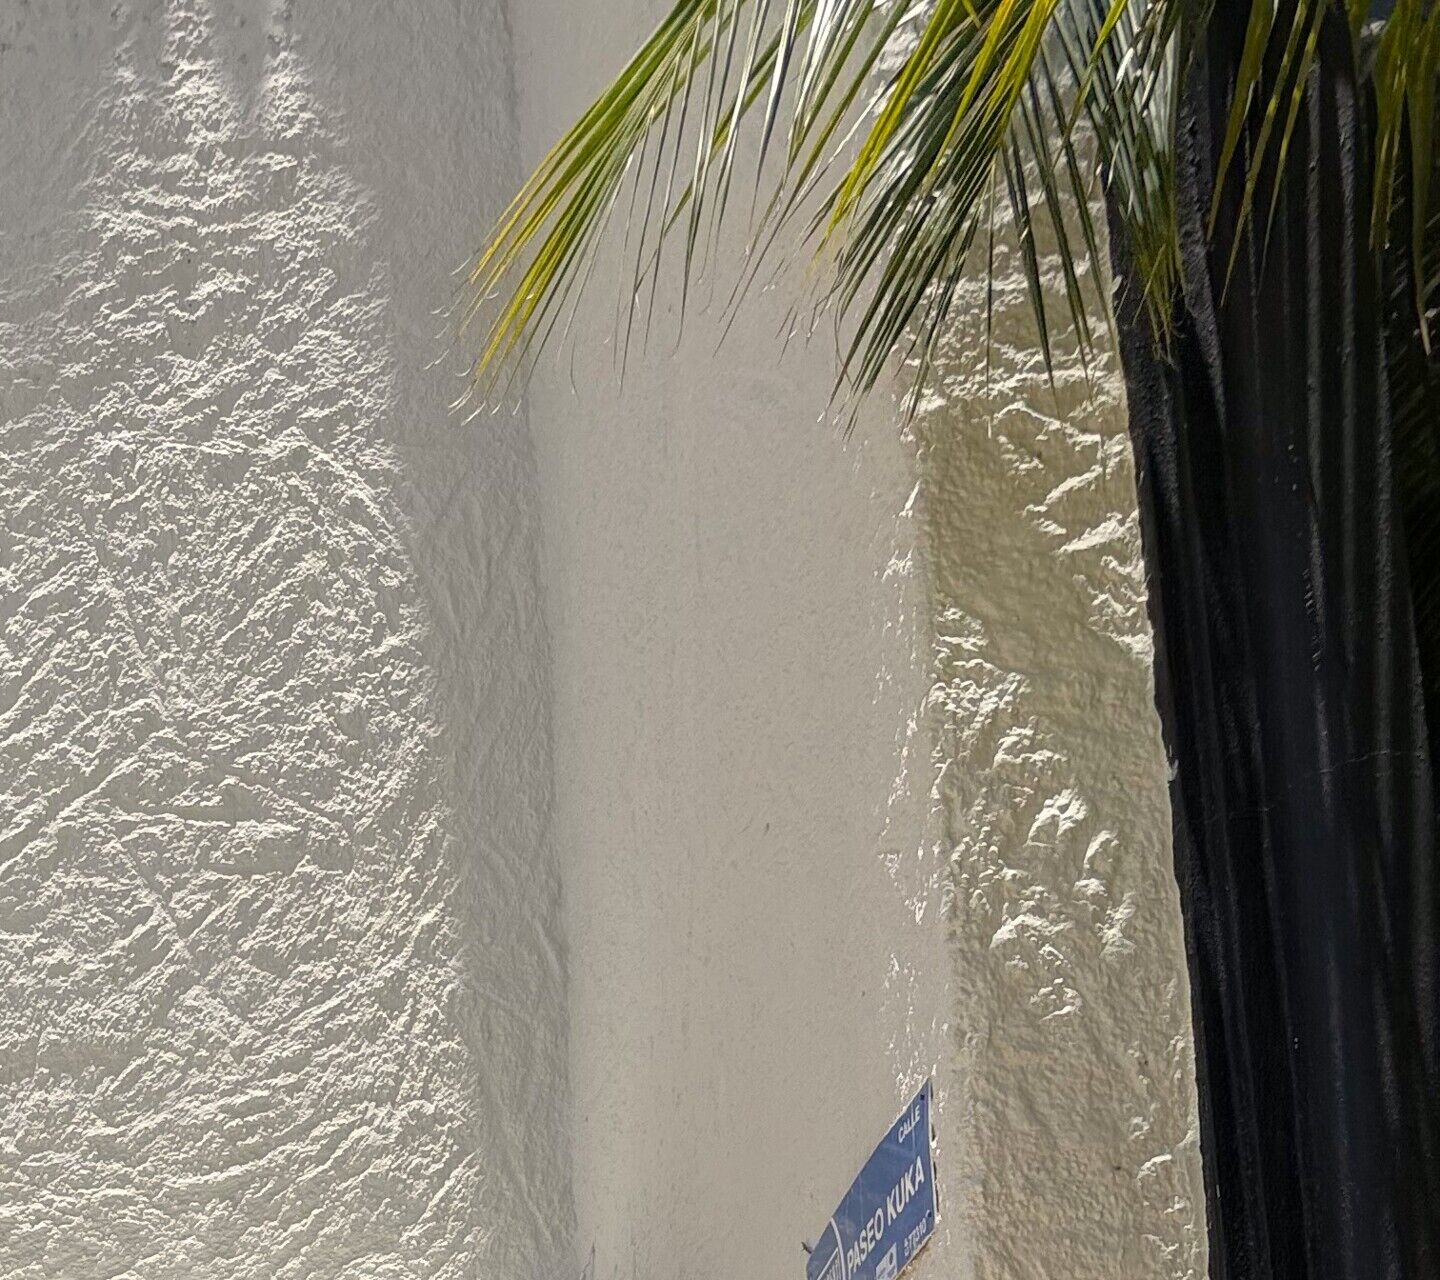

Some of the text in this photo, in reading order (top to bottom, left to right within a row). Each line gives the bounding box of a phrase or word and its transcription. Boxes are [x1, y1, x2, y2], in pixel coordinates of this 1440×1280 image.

[898, 1104, 921, 1144] CALLE
[846, 1207, 884, 1280] PASEO
[886, 1155, 925, 1226] KUKA
